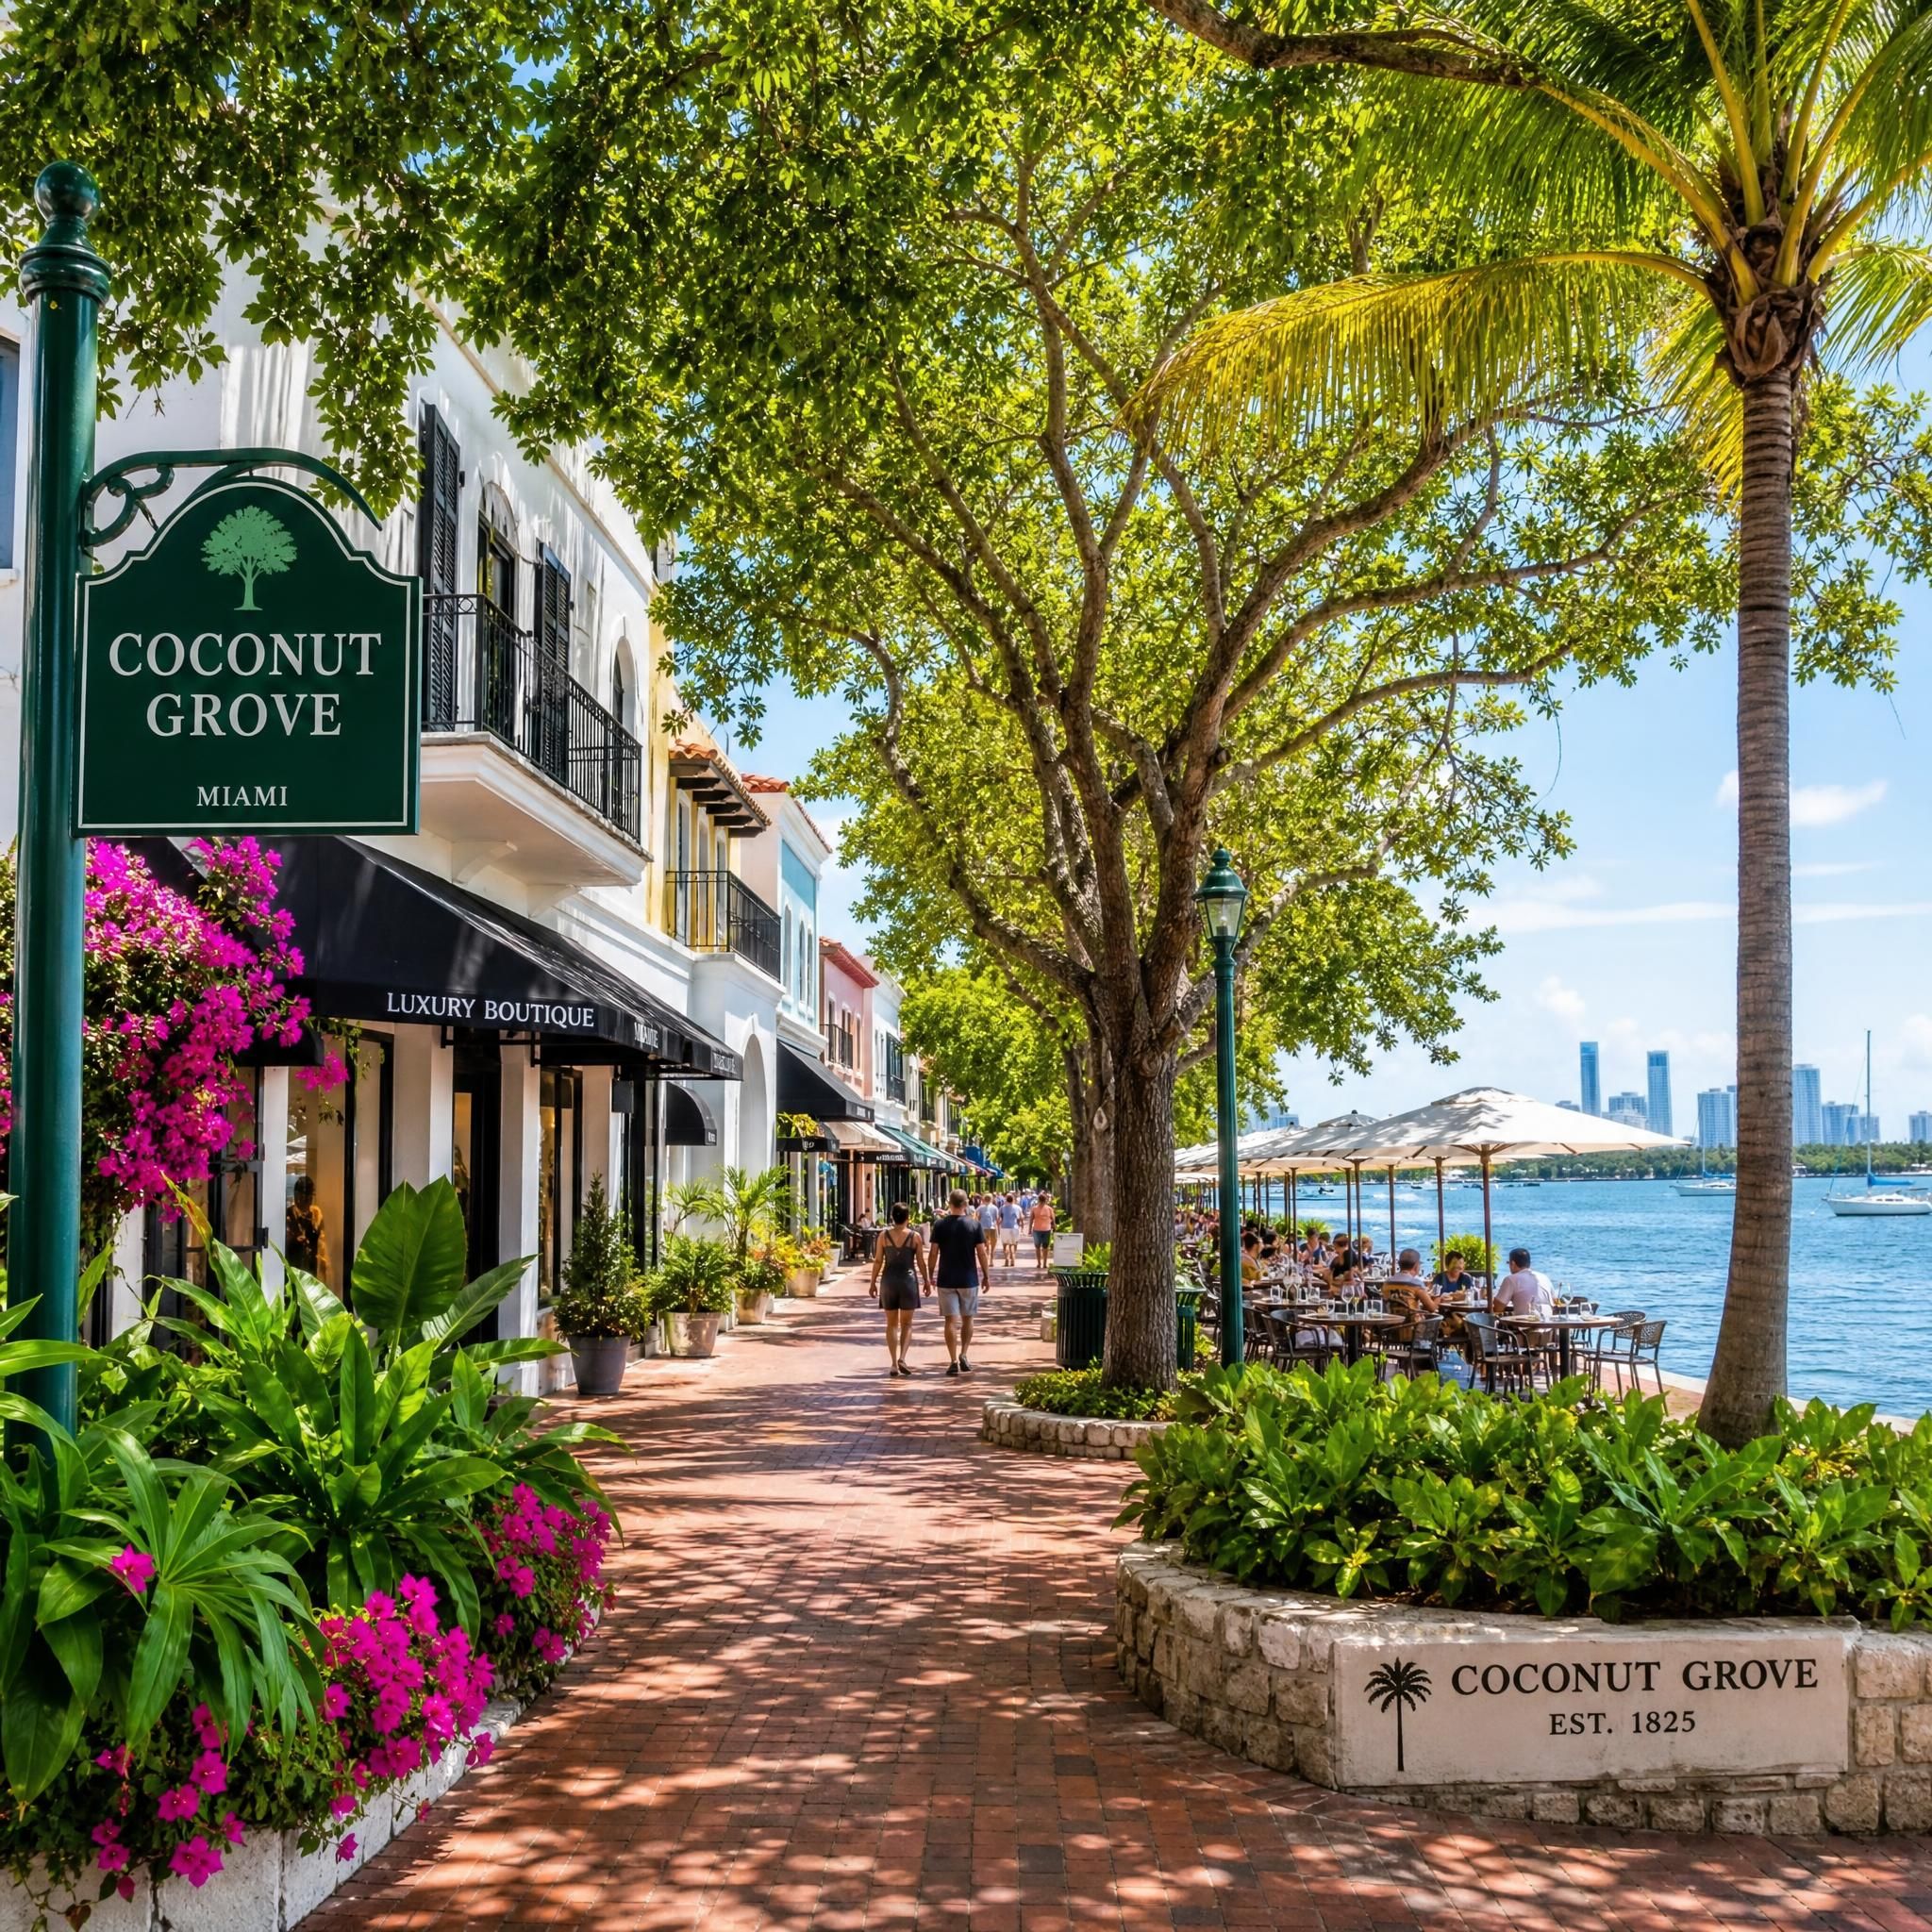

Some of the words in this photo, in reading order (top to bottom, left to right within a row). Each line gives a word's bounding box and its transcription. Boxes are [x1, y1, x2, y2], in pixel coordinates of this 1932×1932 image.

[108, 632, 382, 676] COCONUT
[146, 693, 341, 737] GROVE
[196, 786, 288, 807] MIAMI
[387, 992, 476, 1019] LUXURY
[484, 1000, 594, 1029] BOUTIQUE
[1452, 1660, 1661, 1696] COCONUT
[1681, 1658, 1819, 1691] GROVE
[1548, 1712, 1613, 1736] EST.
[1631, 1710, 1696, 1734] 1825
